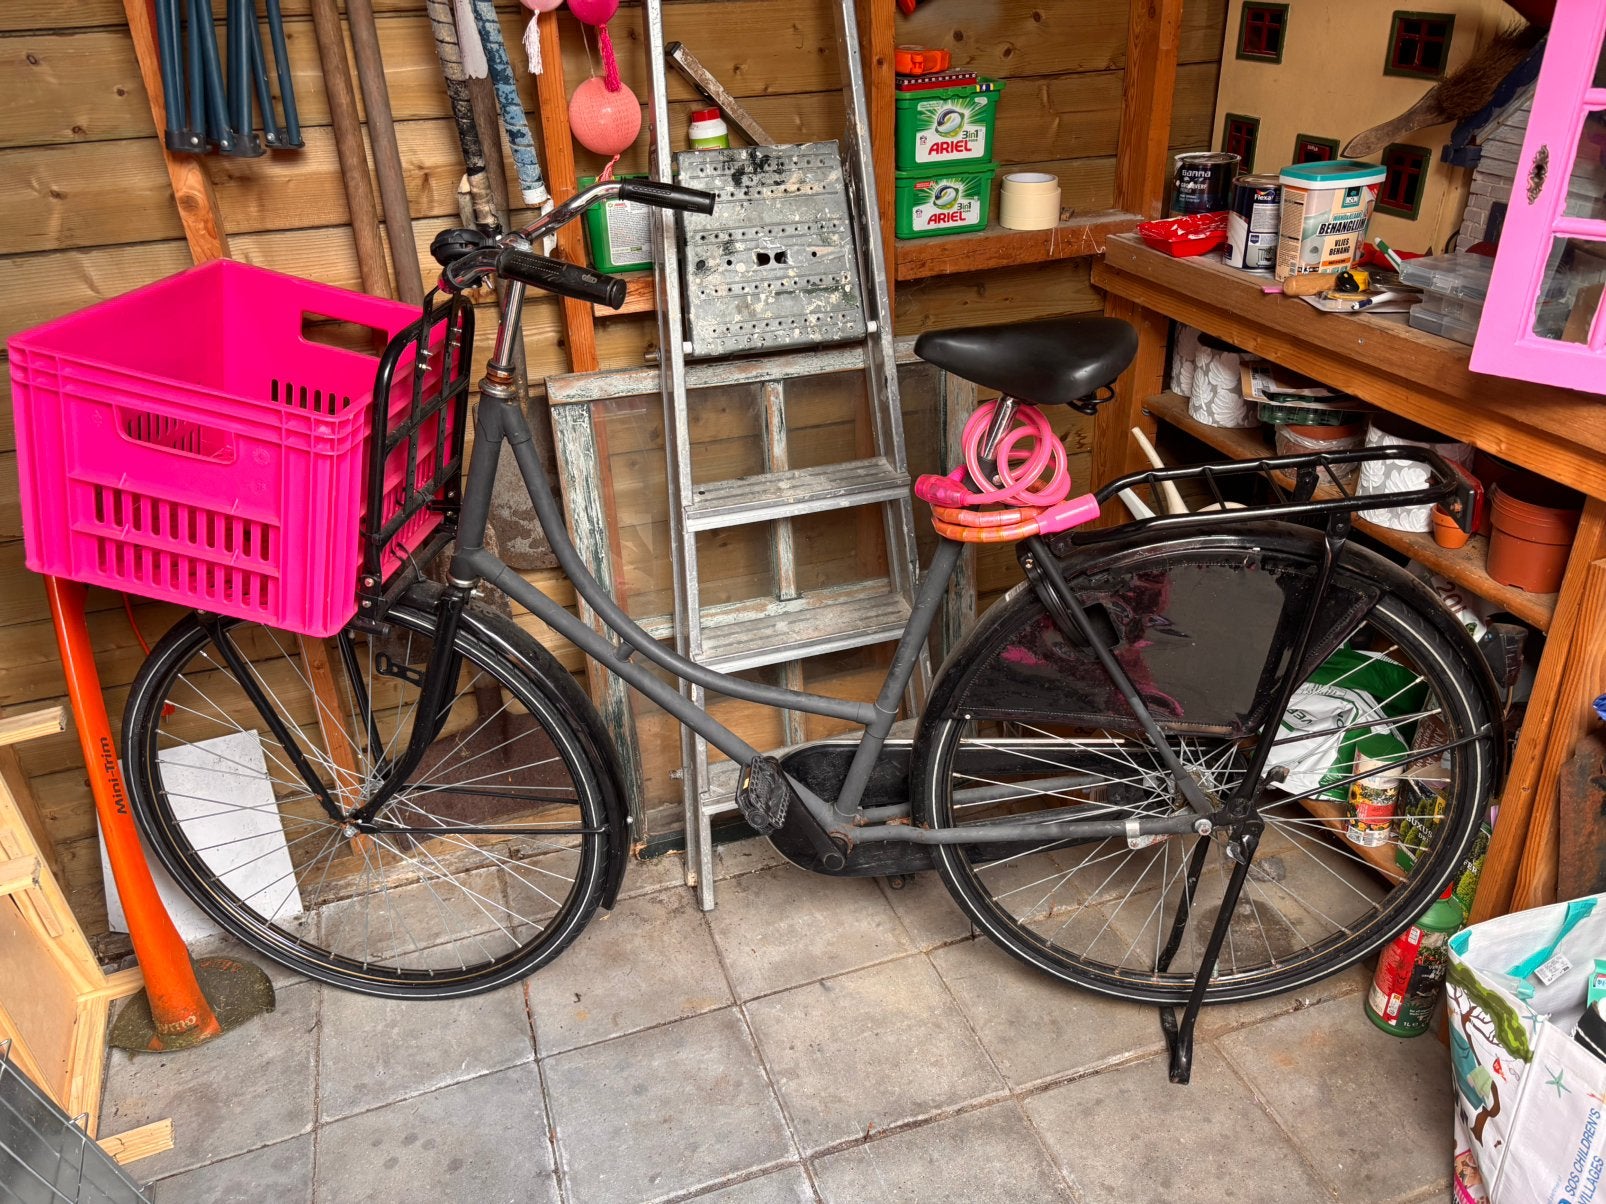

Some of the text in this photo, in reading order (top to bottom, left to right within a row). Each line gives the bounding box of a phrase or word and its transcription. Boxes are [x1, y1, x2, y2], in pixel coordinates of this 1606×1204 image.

[928, 140, 972, 155] ARIEL
[927, 211, 966, 225] ARIEL
[1318, 217, 1367, 235] BEHANGLIJM
[1334, 238, 1350, 247] VLIES
[1328, 246, 1351, 256] BEHANG
[100, 737, 127, 815] Mini-Trim
[1564, 1107, 1601, 1197] SOS CHILDREN'S
